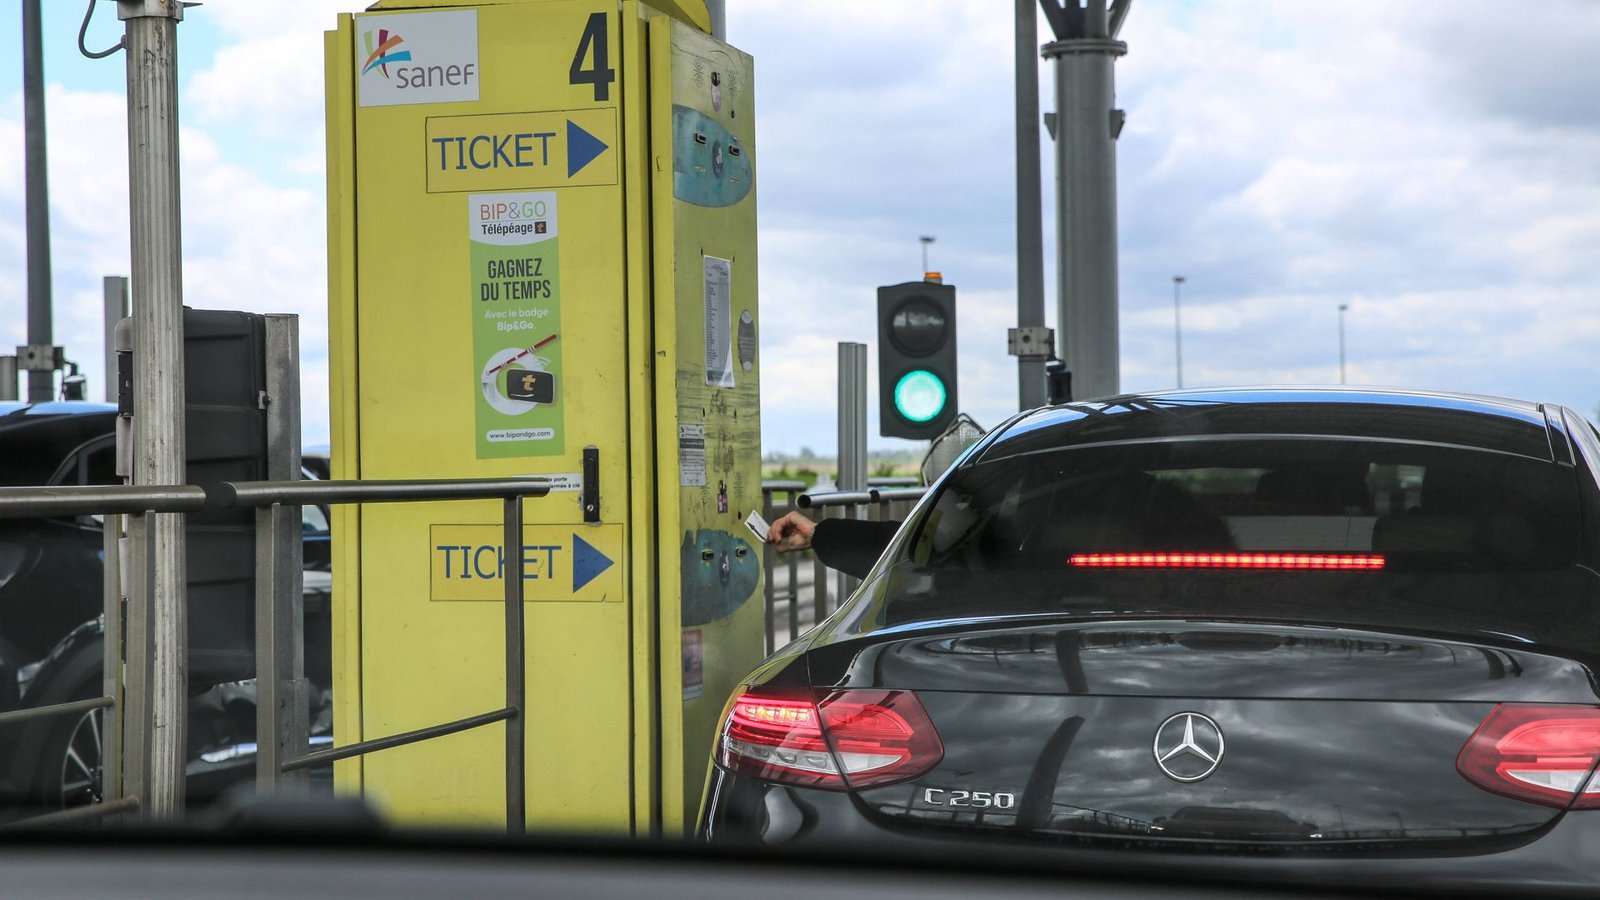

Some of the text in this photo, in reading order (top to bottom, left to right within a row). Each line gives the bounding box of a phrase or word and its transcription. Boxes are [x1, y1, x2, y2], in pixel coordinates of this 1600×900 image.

[569, 12, 615, 102] 4
[396, 63, 475, 89] sanef
[432, 132, 556, 171] TICKET
[480, 200, 546, 221] BIP&GO
[481, 222, 533, 236] Télépéage
[488, 257, 543, 279] GAGNEZ
[481, 279, 551, 302] DU TEMPS
[485, 307, 549, 319] Avec le badge
[489, 431, 551, 439] www.bipandgo.com
